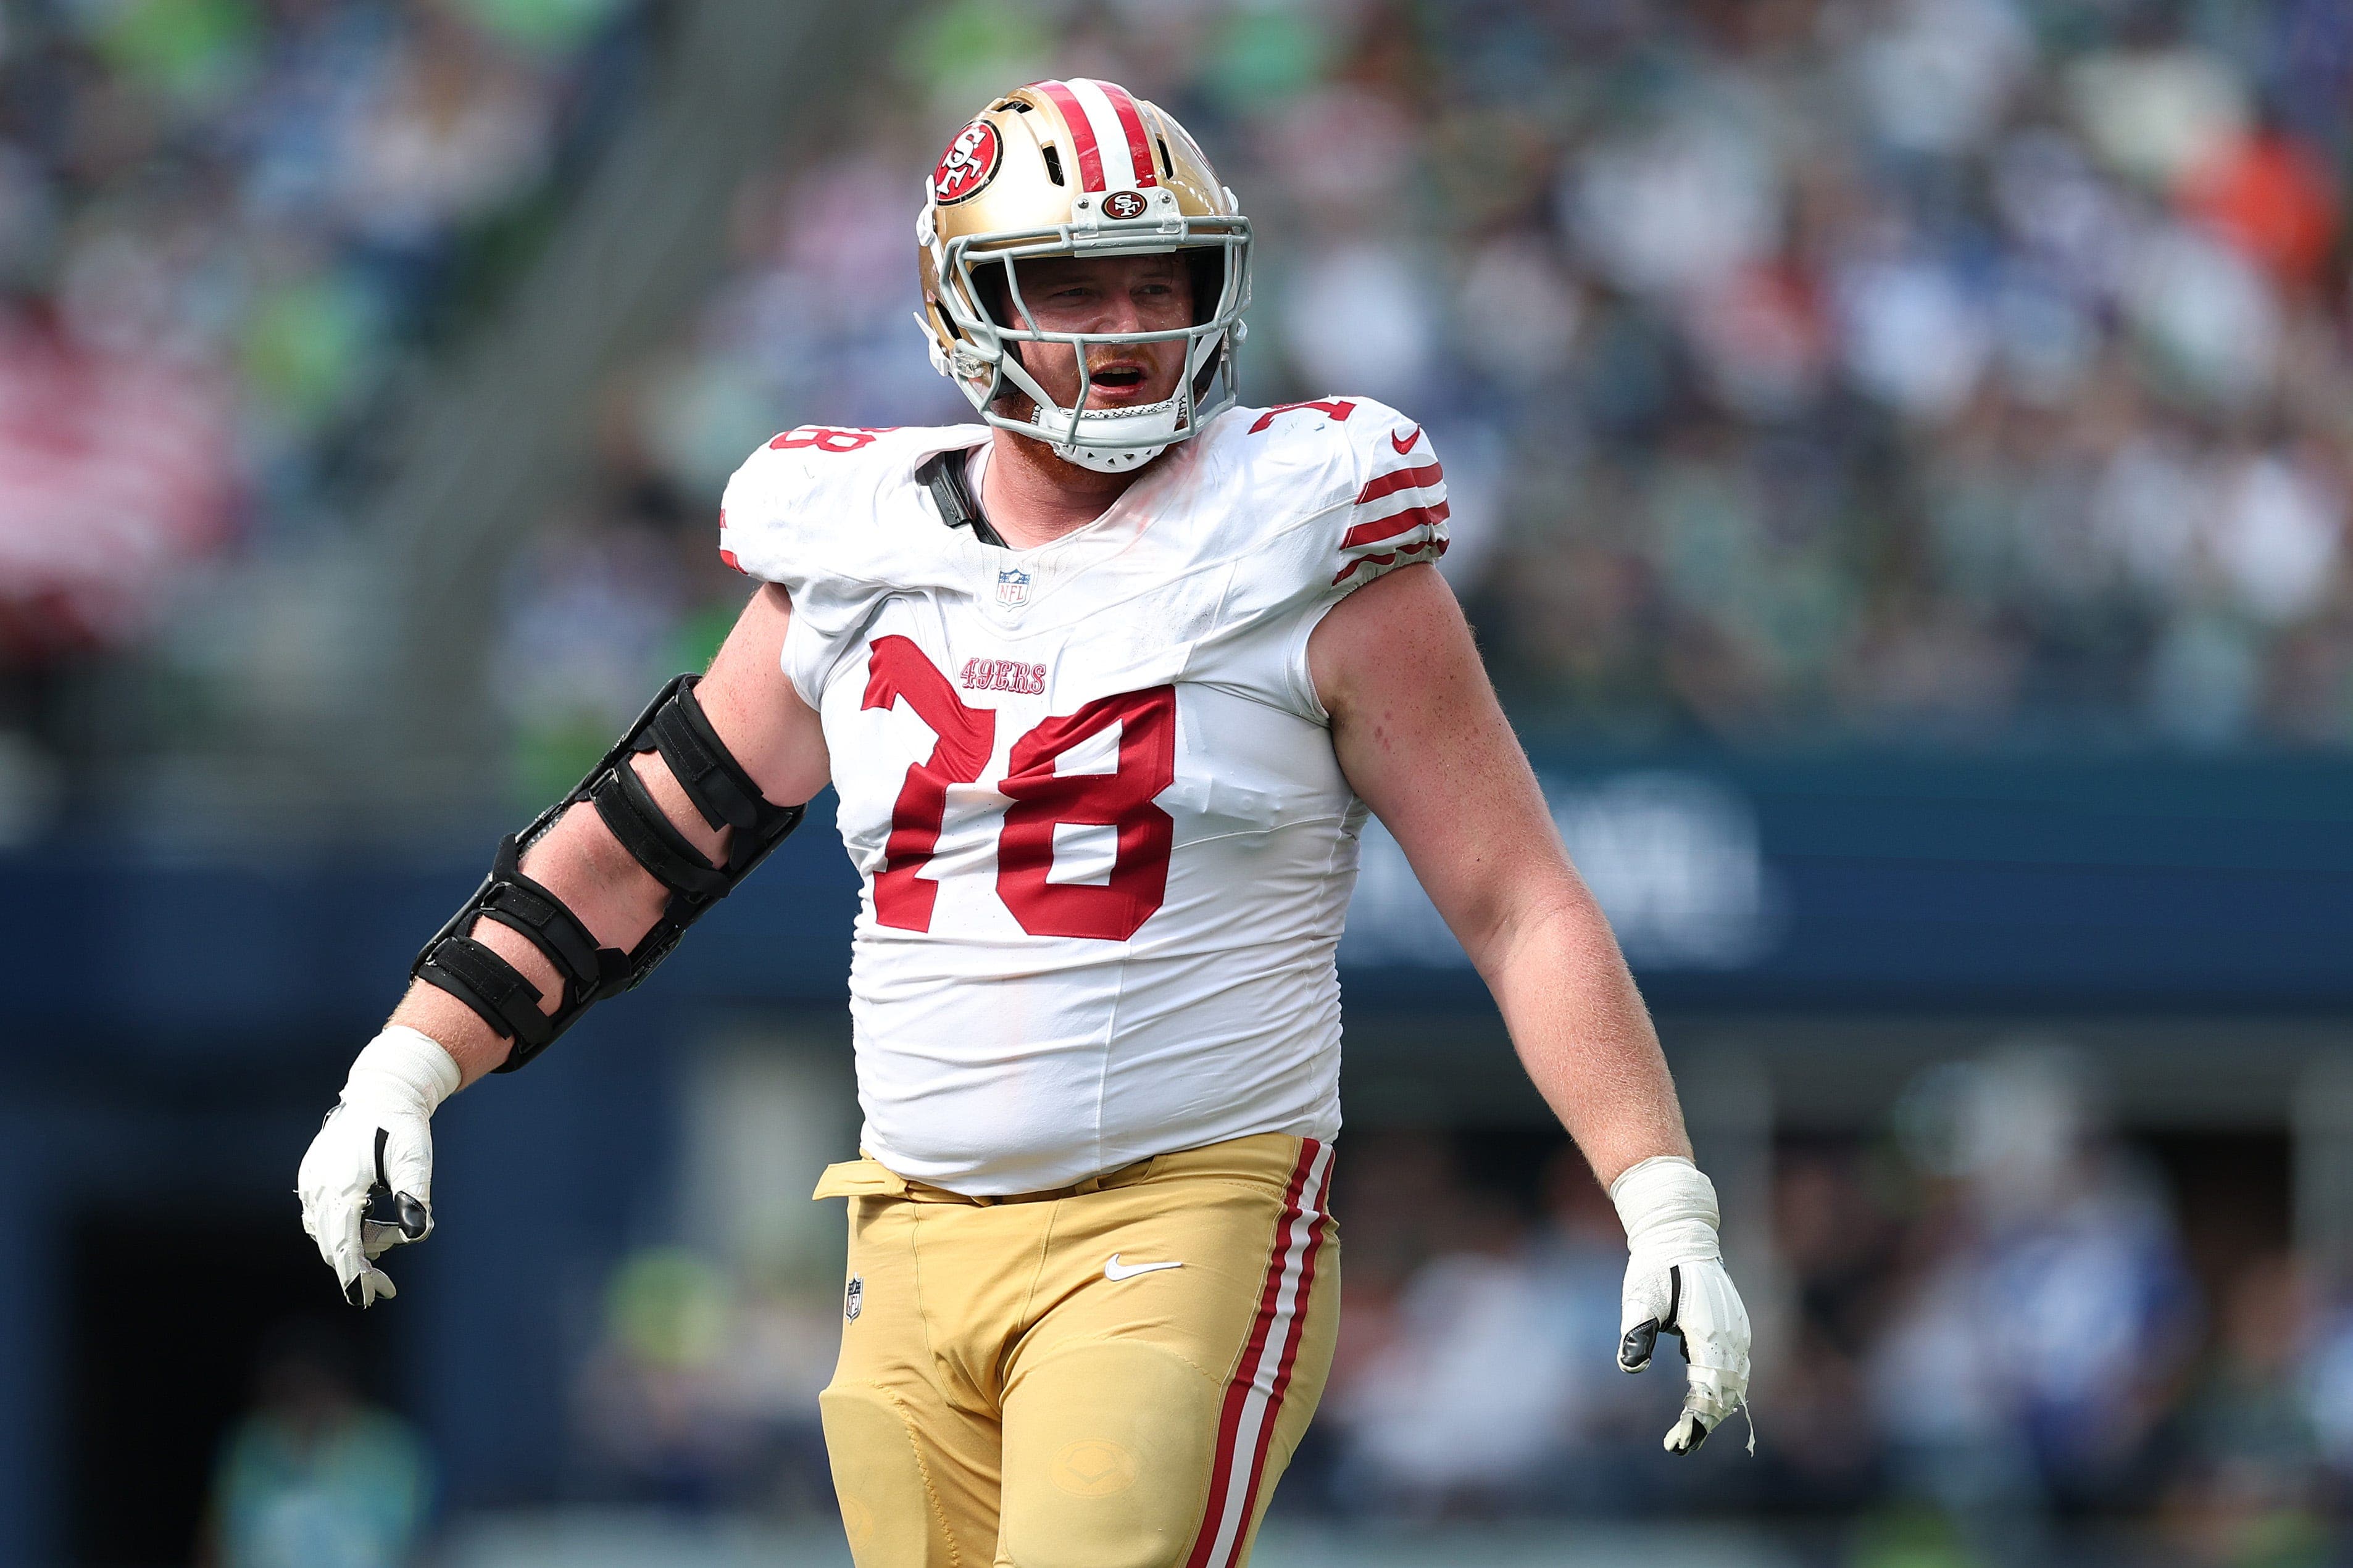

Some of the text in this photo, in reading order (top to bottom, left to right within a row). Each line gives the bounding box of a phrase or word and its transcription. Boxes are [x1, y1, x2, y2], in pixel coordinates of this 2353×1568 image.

[936, 128, 987, 195] SF
[1114, 194, 1140, 217] SF
[1247, 400, 1357, 435] 7
[769, 426, 901, 452] 8
[999, 584, 1024, 602] NFL
[960, 658, 1046, 695] 49ERS
[860, 634, 1176, 942] 78
